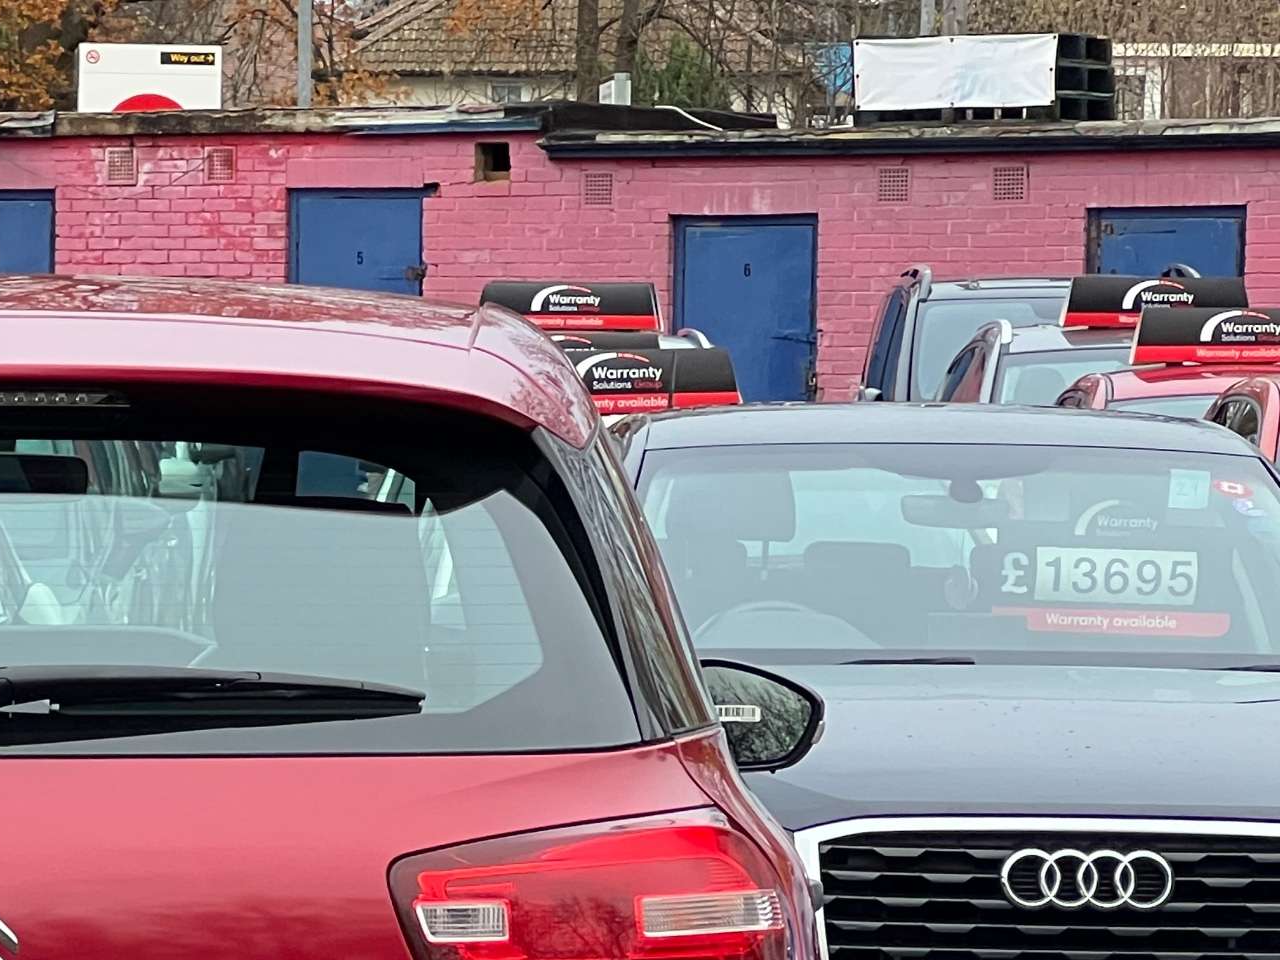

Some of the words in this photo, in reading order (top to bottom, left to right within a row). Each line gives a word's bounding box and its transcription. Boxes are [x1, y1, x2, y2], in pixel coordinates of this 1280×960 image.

[356, 251, 364, 265] 5
[743, 263, 751, 278] 6
[549, 294, 601, 307] Warranty
[1141, 291, 1194, 304] Warranty
[1221, 322, 1280, 335] Warranty
[592, 367, 662, 381] Warranty
[592, 381, 632, 389] Solutions
[617, 397, 669, 407] available
[1096, 515, 1158, 530] Warranty
[1046, 613, 1109, 629] Warranty
[1113, 614, 1176, 629] available
